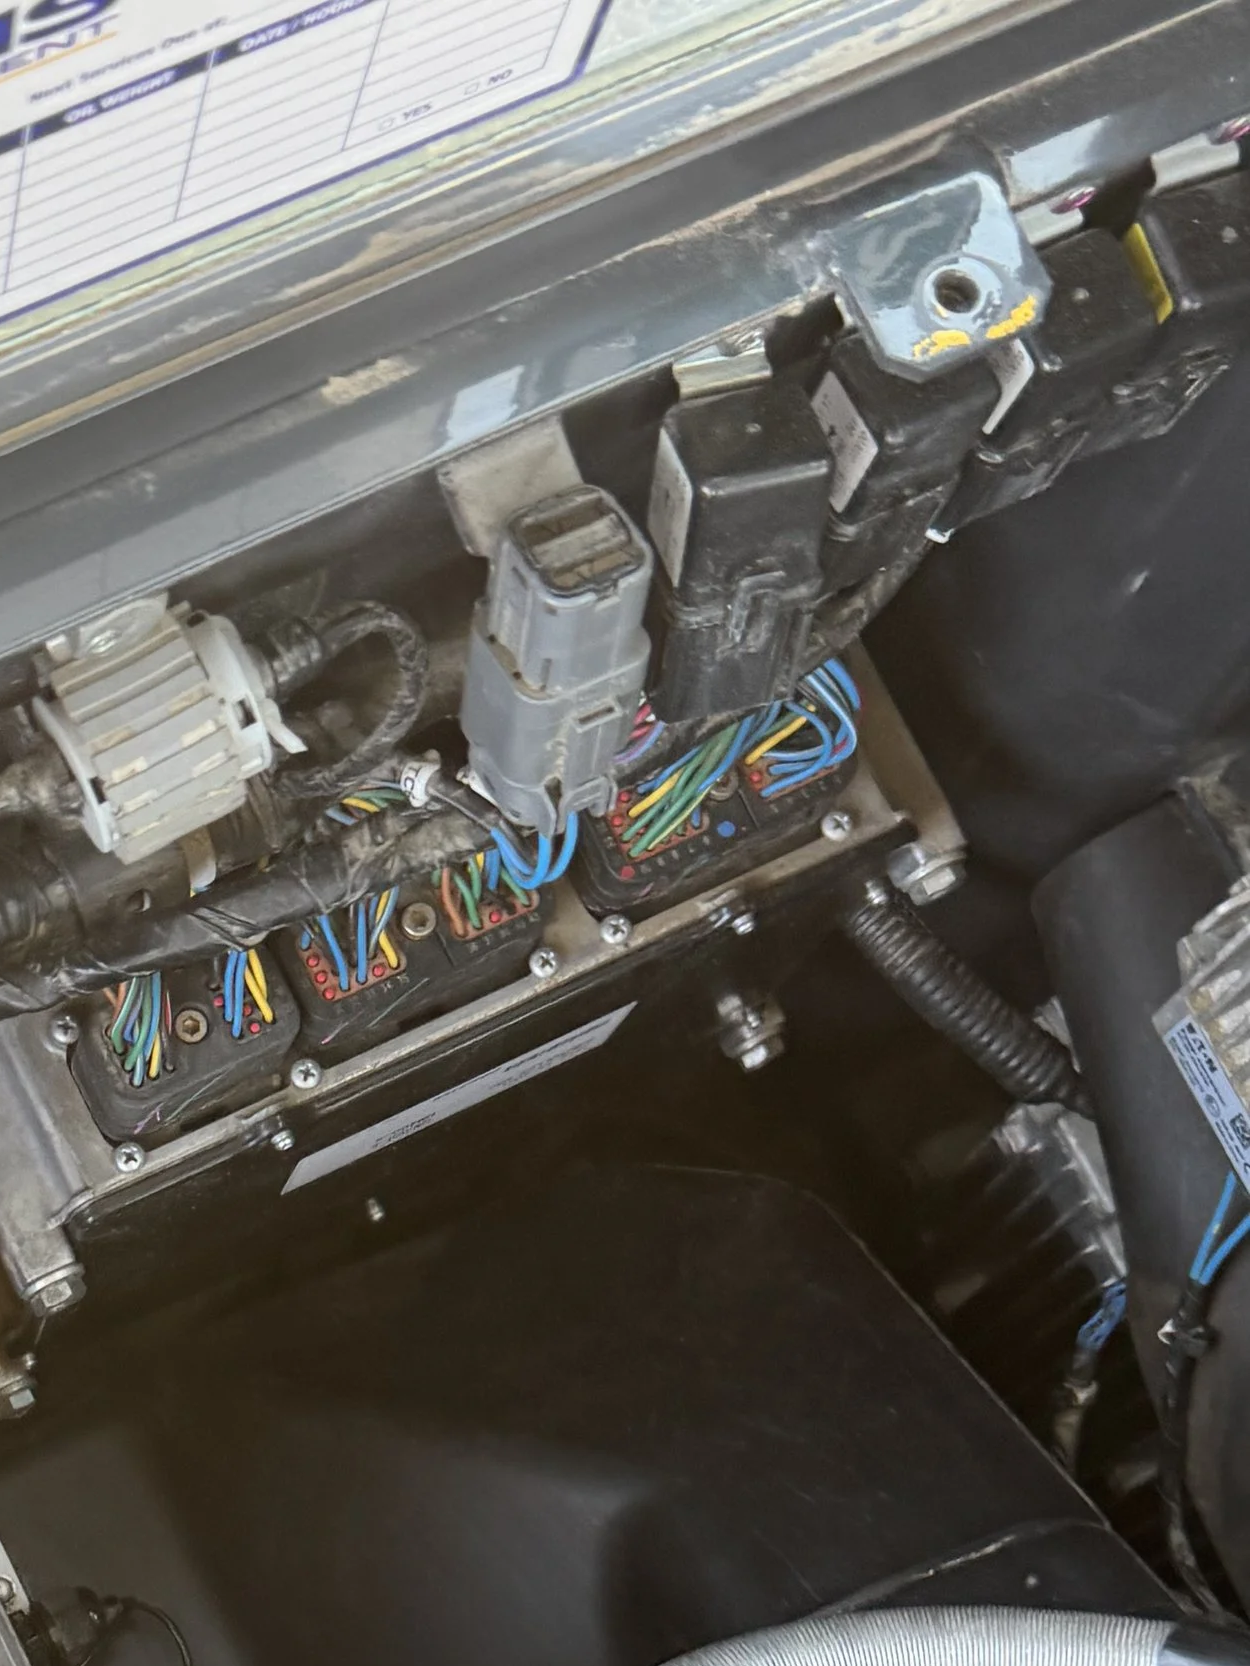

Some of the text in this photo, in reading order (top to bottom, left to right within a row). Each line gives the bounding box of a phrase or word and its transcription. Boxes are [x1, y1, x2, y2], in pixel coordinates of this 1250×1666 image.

[238, 23, 289, 52] DATE
[486, 68, 514, 86] NO
[61, 100, 98, 124] OIL
[402, 102, 433, 120] YES
